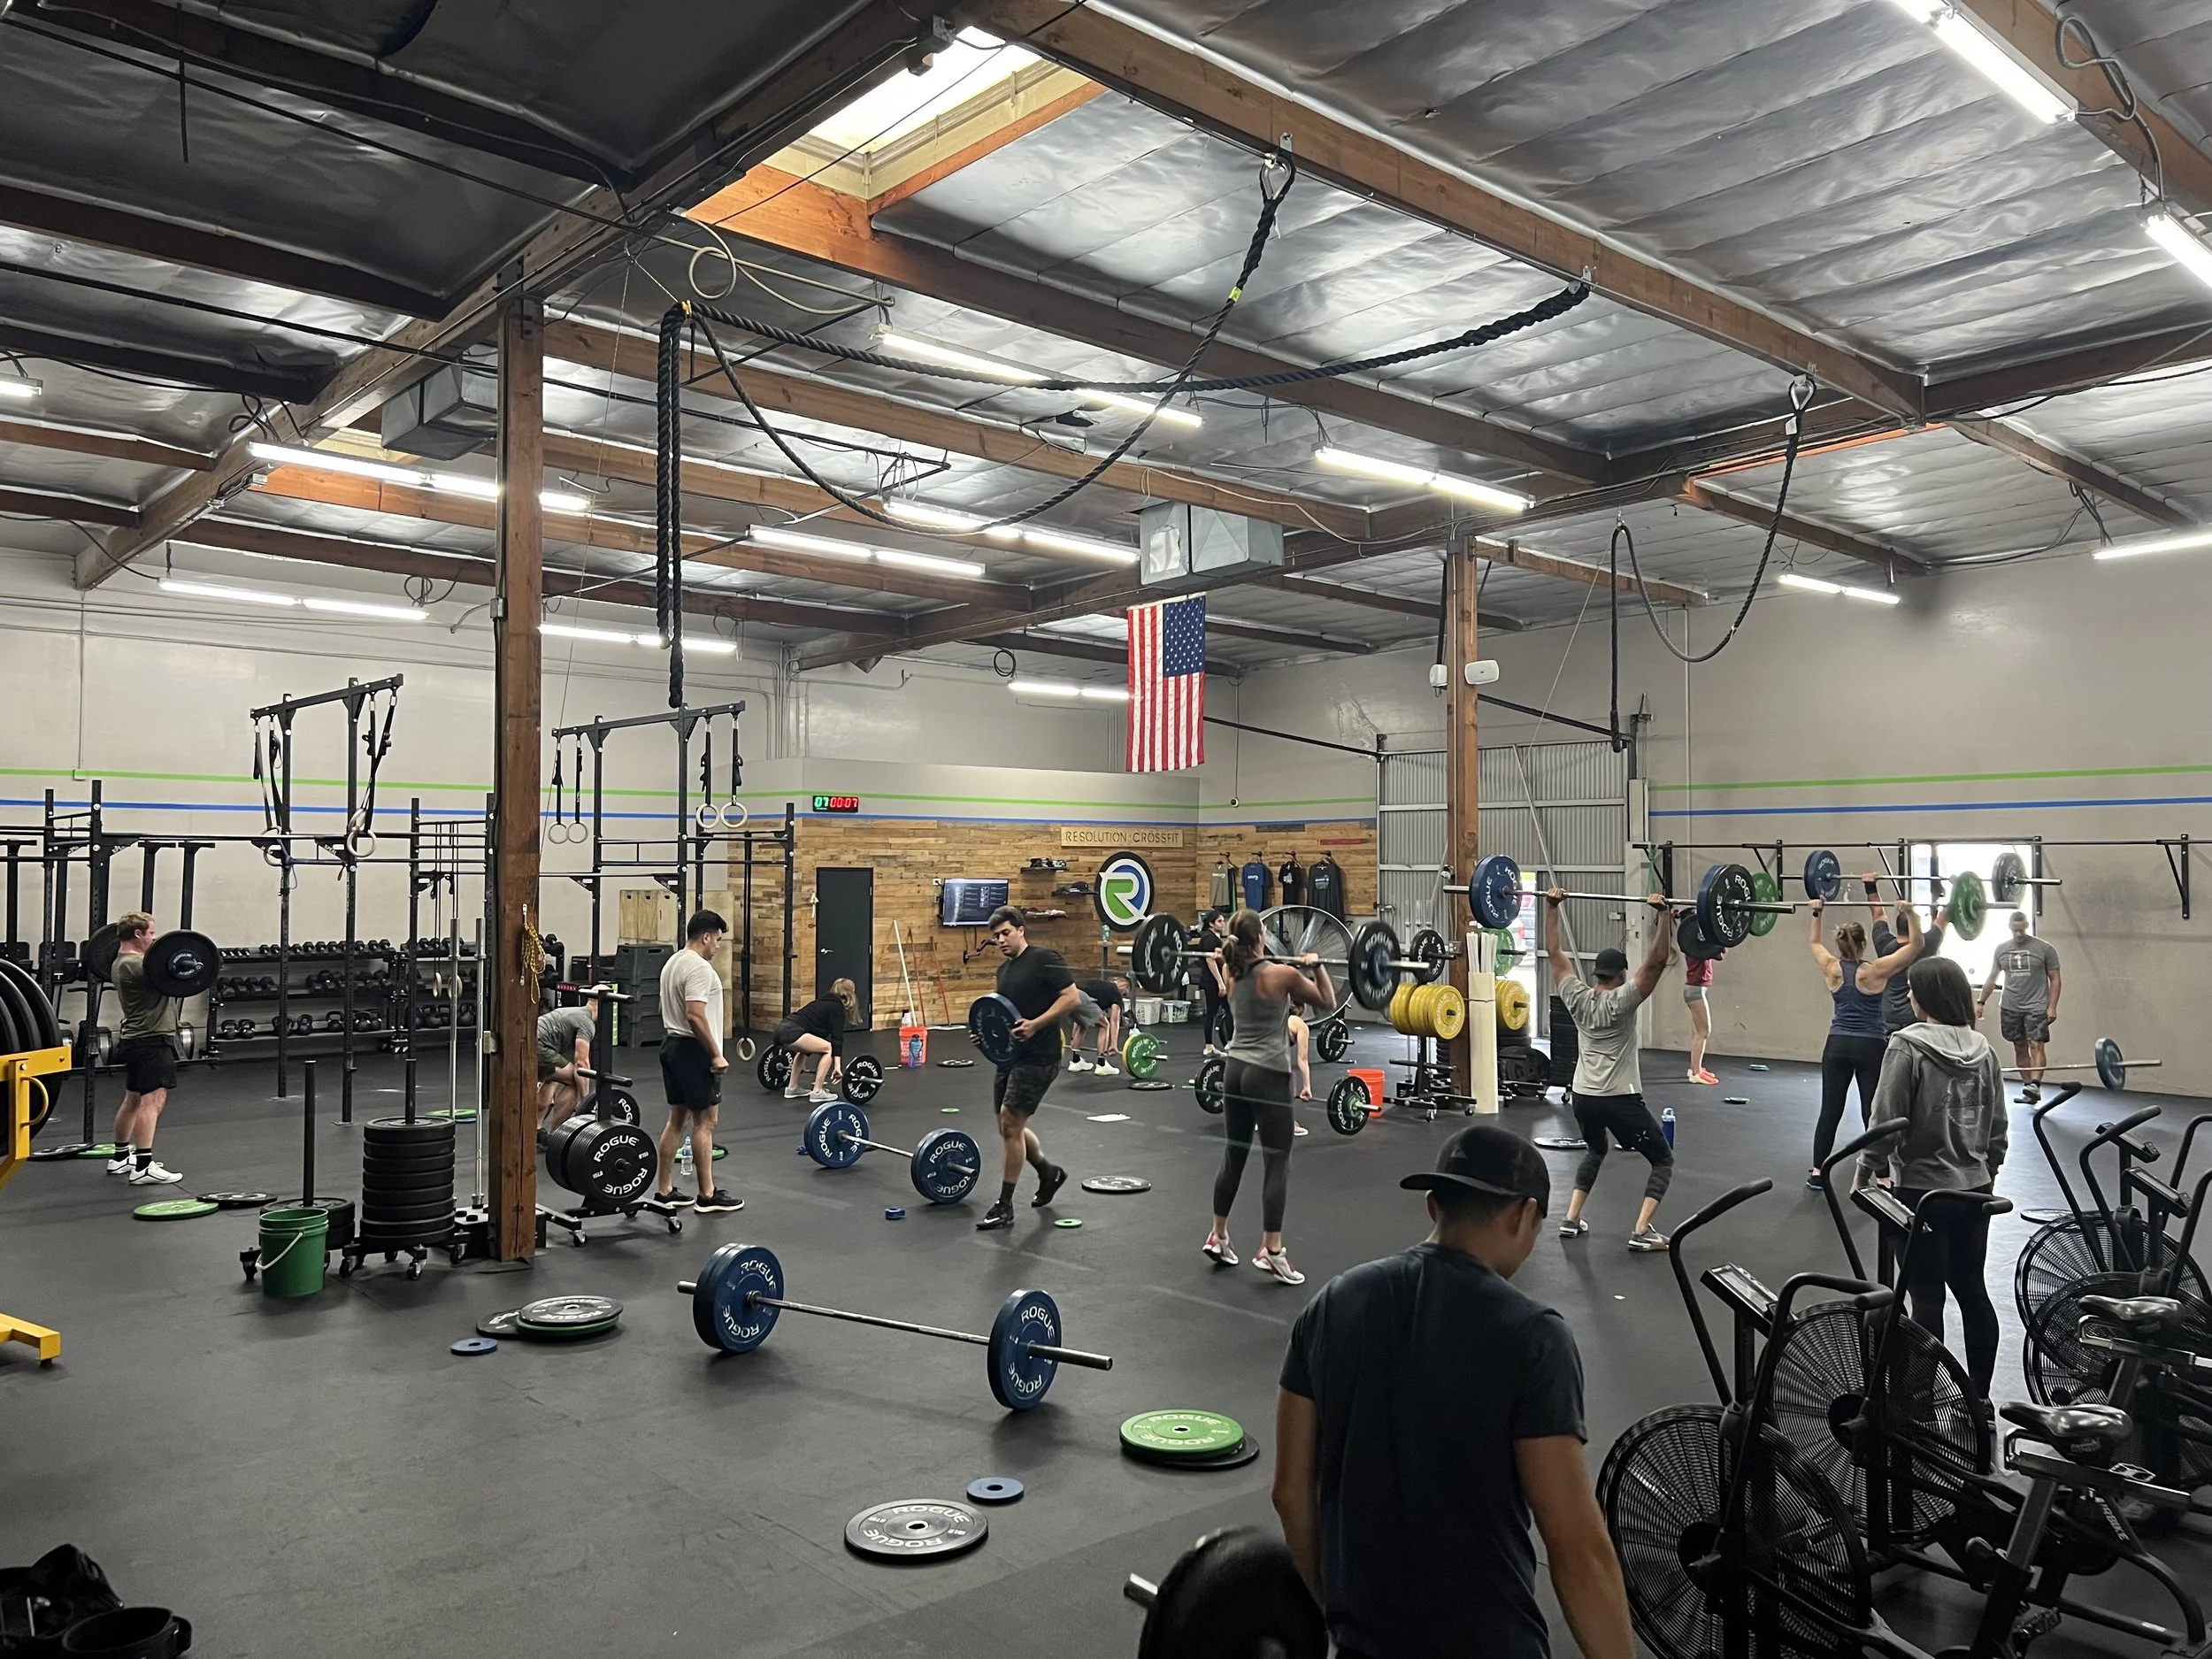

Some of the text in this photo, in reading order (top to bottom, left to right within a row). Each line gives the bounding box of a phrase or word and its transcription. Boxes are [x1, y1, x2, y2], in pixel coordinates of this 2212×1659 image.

[814, 796, 829, 807] 07
[1065, 831, 1179, 843] RESOLUTION CROSSFIT
[1486, 876, 1500, 918] ROGUE
[1716, 894, 1734, 938] ROGUE
[1417, 937, 1428, 963] OGUE
[764, 1051, 774, 1082] ROGUE
[856, 1061, 879, 1078] ROGUE
[1141, 1059, 1156, 1073] OGUE
[618, 1098, 634, 1124] ROG
[1337, 1087, 1347, 1125] ROGUE
[594, 1134, 640, 1163] ROGUE
[818, 1117, 833, 1158] ROGUE
[929, 1140, 968, 1164] ROGUE
[602, 1167, 649, 1194] ROGUE
[741, 1259, 777, 1292] ROGUE
[722, 1304, 760, 1339] ROGUE
[1020, 1305, 1056, 1340] ROGUE
[1008, 1362, 1042, 1394] ROGUE
[1148, 1414, 1222, 1425] ROGUE
[1139, 1433, 1216, 1445] ROGUE
[892, 1505, 971, 1525] ROGUE
[863, 1529, 944, 1548] ROGUE
